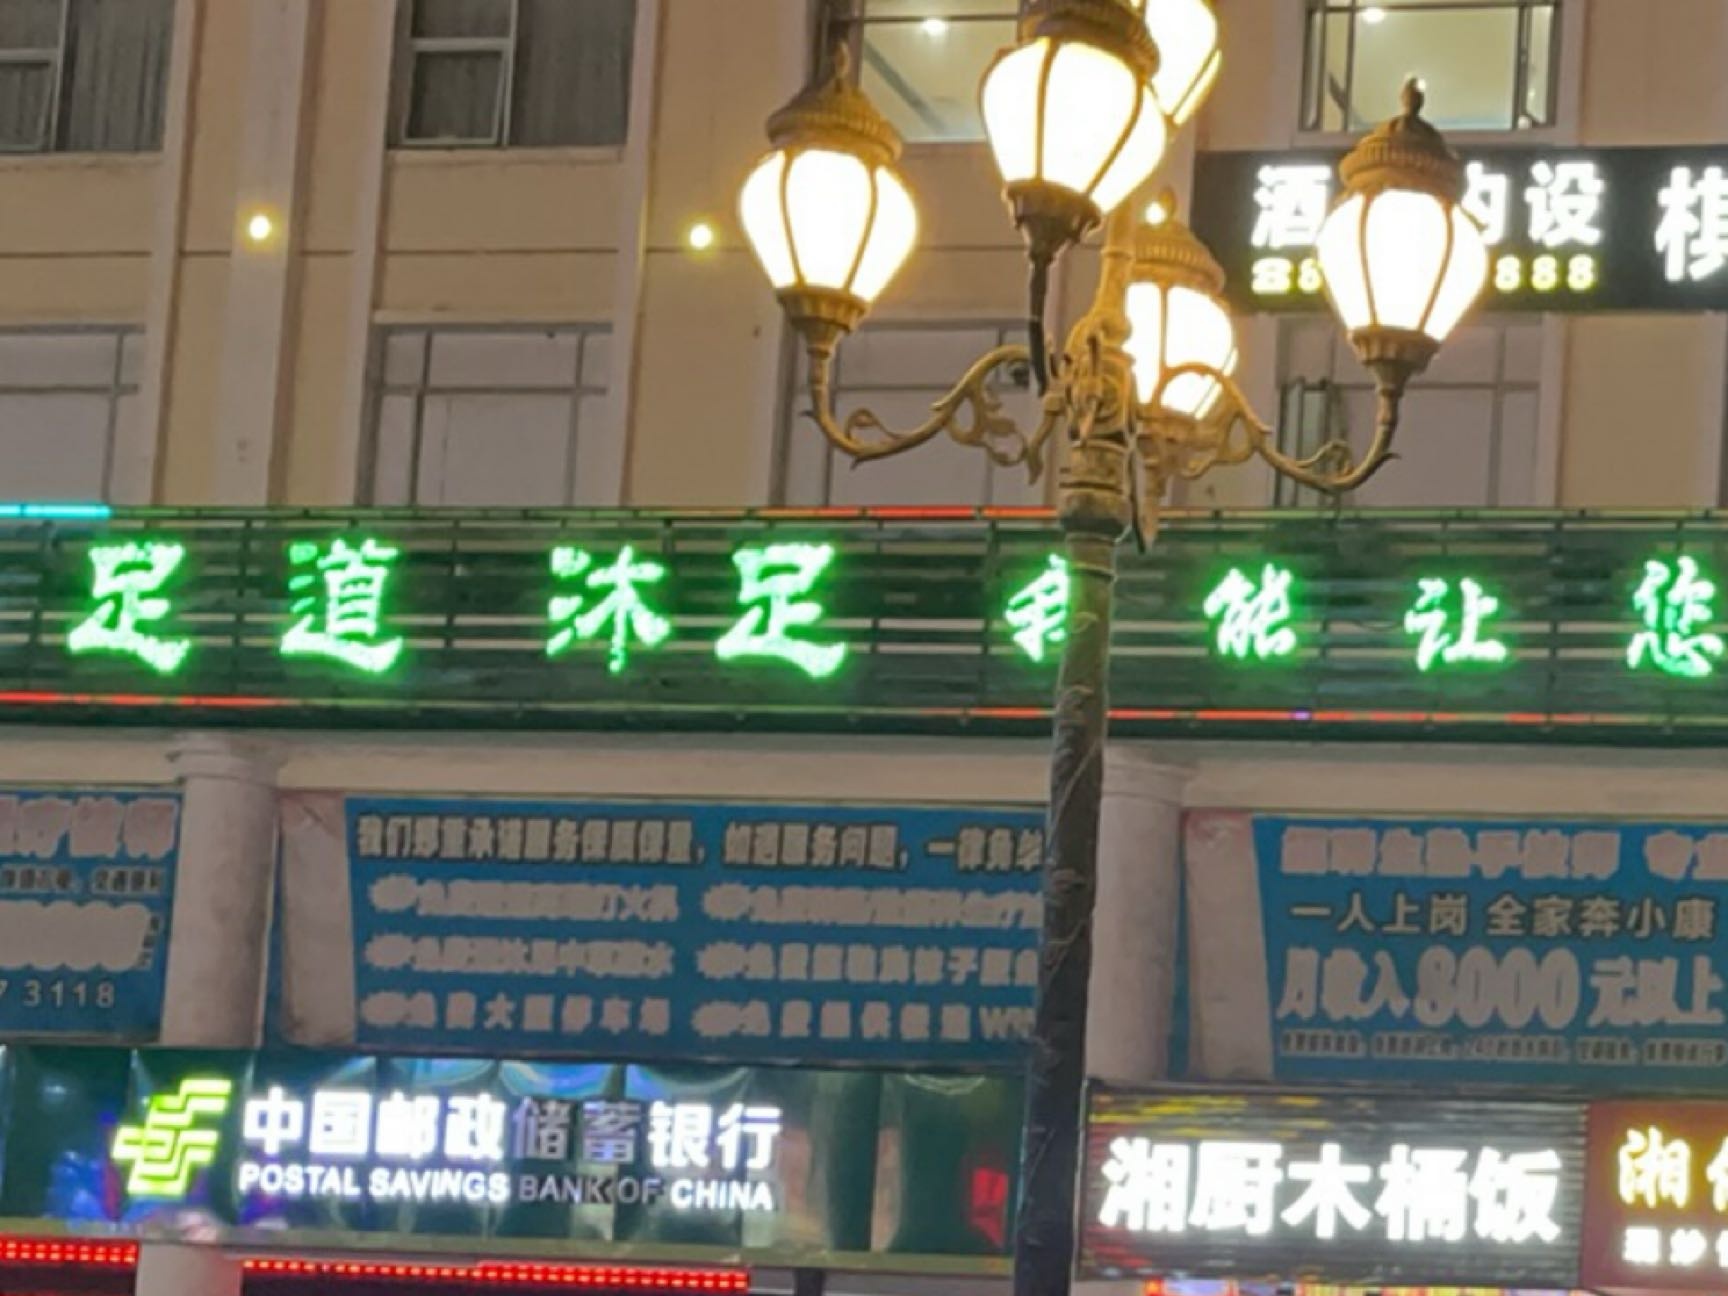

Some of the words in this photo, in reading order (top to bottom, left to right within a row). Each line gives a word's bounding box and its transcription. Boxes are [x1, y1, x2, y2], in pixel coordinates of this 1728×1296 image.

[1250, 161, 1604, 250] 酒内设
[1290, 893, 1468, 936] 一人上岗
[1486, 895, 1715, 940] 全家奔小康
[242, 1086, 782, 1170] 中国邮政储蓄银行
[237, 1162, 361, 1196] POSTAL
[368, 1166, 511, 1204] SAVINGS
[518, 1174, 613, 1204] BANK
[618, 1176, 663, 1203] OF
[669, 1176, 775, 1212] CHINA
[1098, 1136, 1563, 1244] 湘厨木桶饭
